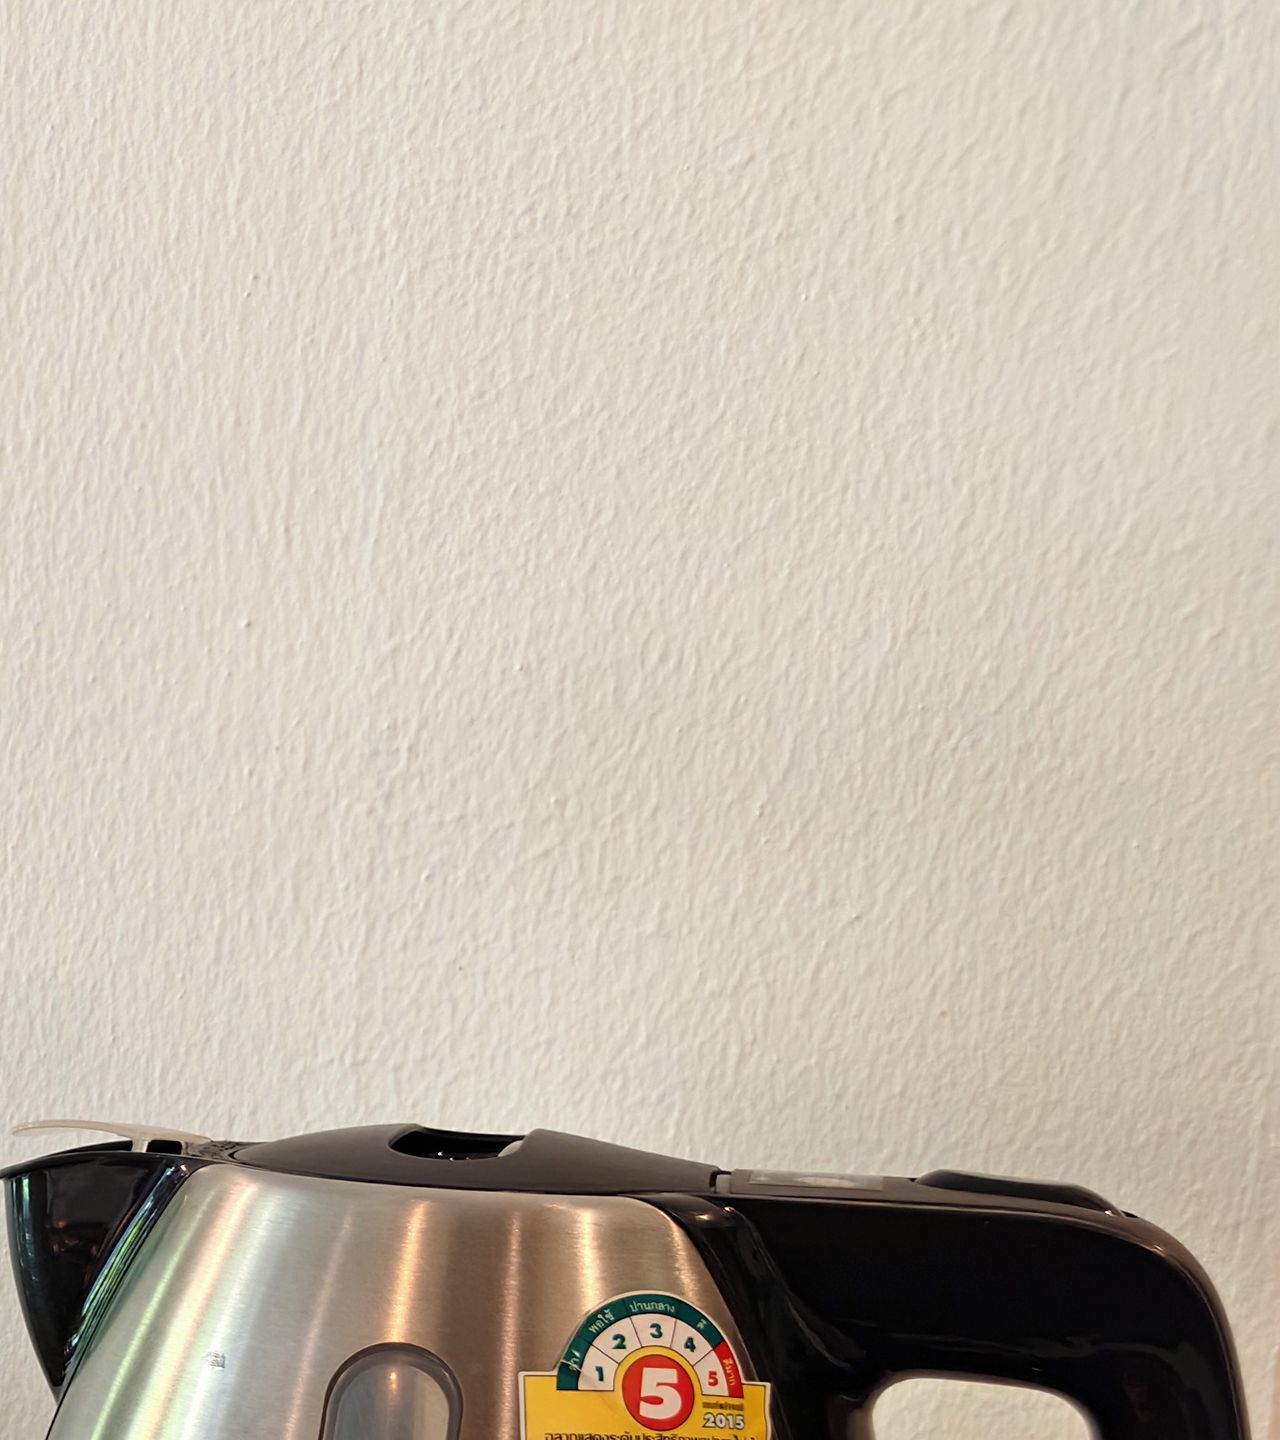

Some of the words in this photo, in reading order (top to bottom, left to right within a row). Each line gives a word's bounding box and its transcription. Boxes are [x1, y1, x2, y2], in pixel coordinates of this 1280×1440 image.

[649, 1322, 663, 1339] 3
[612, 1333, 627, 1350] 2
[683, 1336, 697, 1353] 4
[594, 1365, 605, 1382] 1
[707, 1370, 719, 1387] 5
[639, 1367, 683, 1420] 5
[702, 1412, 745, 1431] 2015
